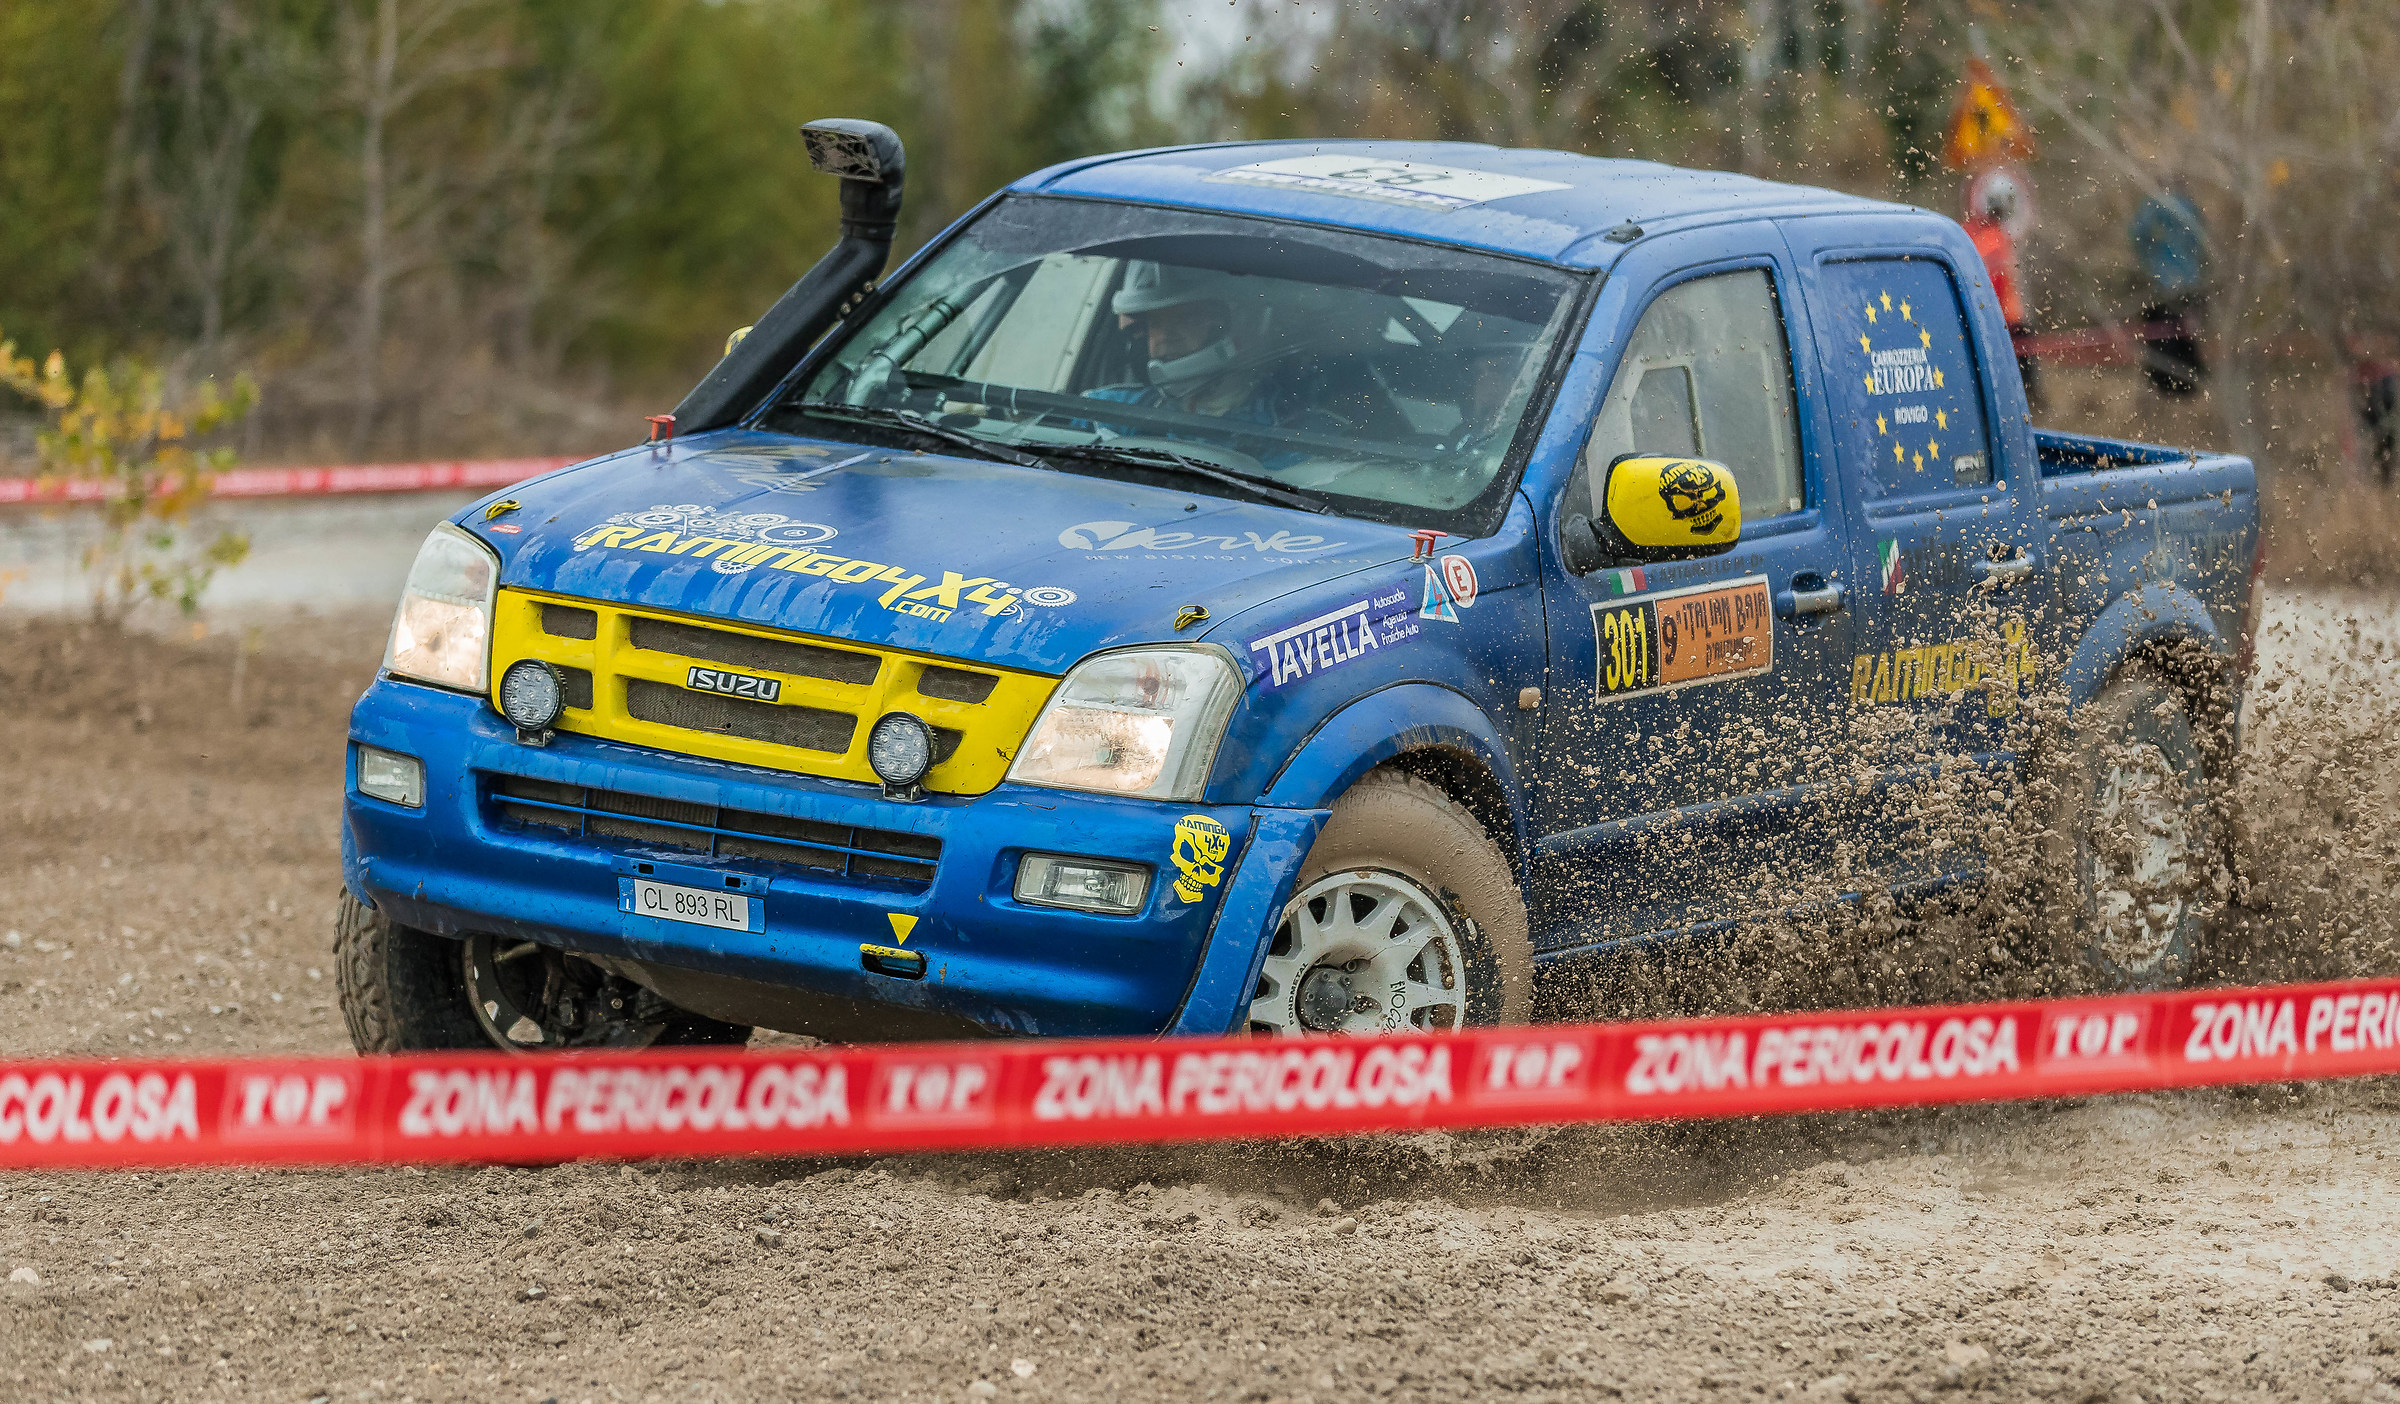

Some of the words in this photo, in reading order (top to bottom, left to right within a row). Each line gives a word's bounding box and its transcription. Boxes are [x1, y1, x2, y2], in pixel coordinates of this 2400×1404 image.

[1873, 364, 1935, 395] EUROPA
[1894, 405, 1928, 424] ROVIGO
[1452, 565, 1468, 592] E
[888, 600, 952, 623] .com
[1373, 588, 1406, 610] Autoscuola
[1382, 611, 1408, 629] Agenzia
[1682, 596, 1732, 640] ITALIAN
[1734, 592, 1767, 632] BAJA
[1250, 599, 1379, 687] TAVELLA
[1381, 626, 1406, 646] Pratiche
[1405, 623, 1419, 638] Auto
[1604, 607, 1648, 691] 301
[687, 668, 778, 700] ISUZU
[1178, 818, 1228, 836] RAMINGO
[1204, 834, 1226, 852] 4X4
[643, 887, 669, 912] CL
[675, 892, 708, 917] 893
[714, 898, 741, 923] RL
[0, 1072, 199, 1144] COLOSA
[242, 1077, 347, 1126] TOP
[400, 1070, 537, 1136] ZONA
[544, 1064, 848, 1133] PERICOLOSA
[887, 1066, 987, 1112] TOP
[1034, 1056, 1165, 1119] ZONA
[1169, 1045, 1452, 1115] PERICOLOSA
[1486, 1045, 1581, 1088] TOP
[1626, 1032, 1747, 1094] ZONA
[1753, 1016, 2019, 1087] PERICOLOSA
[2051, 1015, 2138, 1057] TOP
[2185, 1001, 2296, 1062] ZONA
[2306, 992, 2400, 1054] PERI
